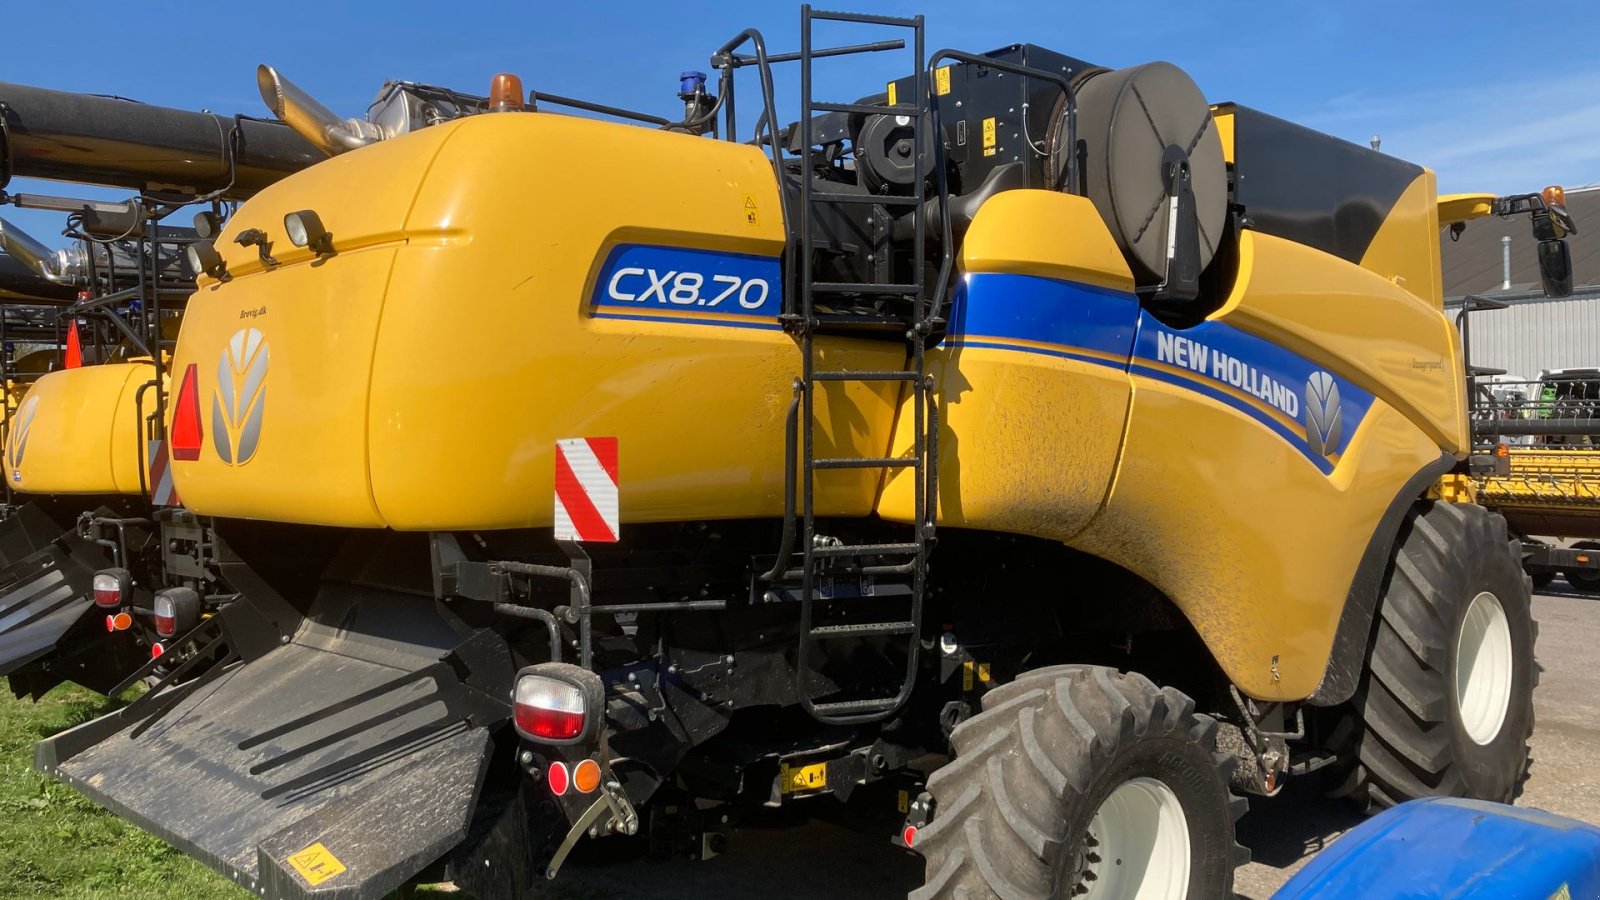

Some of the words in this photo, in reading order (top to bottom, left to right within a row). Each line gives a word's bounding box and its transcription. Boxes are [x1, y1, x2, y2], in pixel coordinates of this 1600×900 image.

[608, 267, 769, 309] CX8.70
[1157, 330, 1208, 374] NEW
[1212, 349, 1299, 418] HOLLAND
